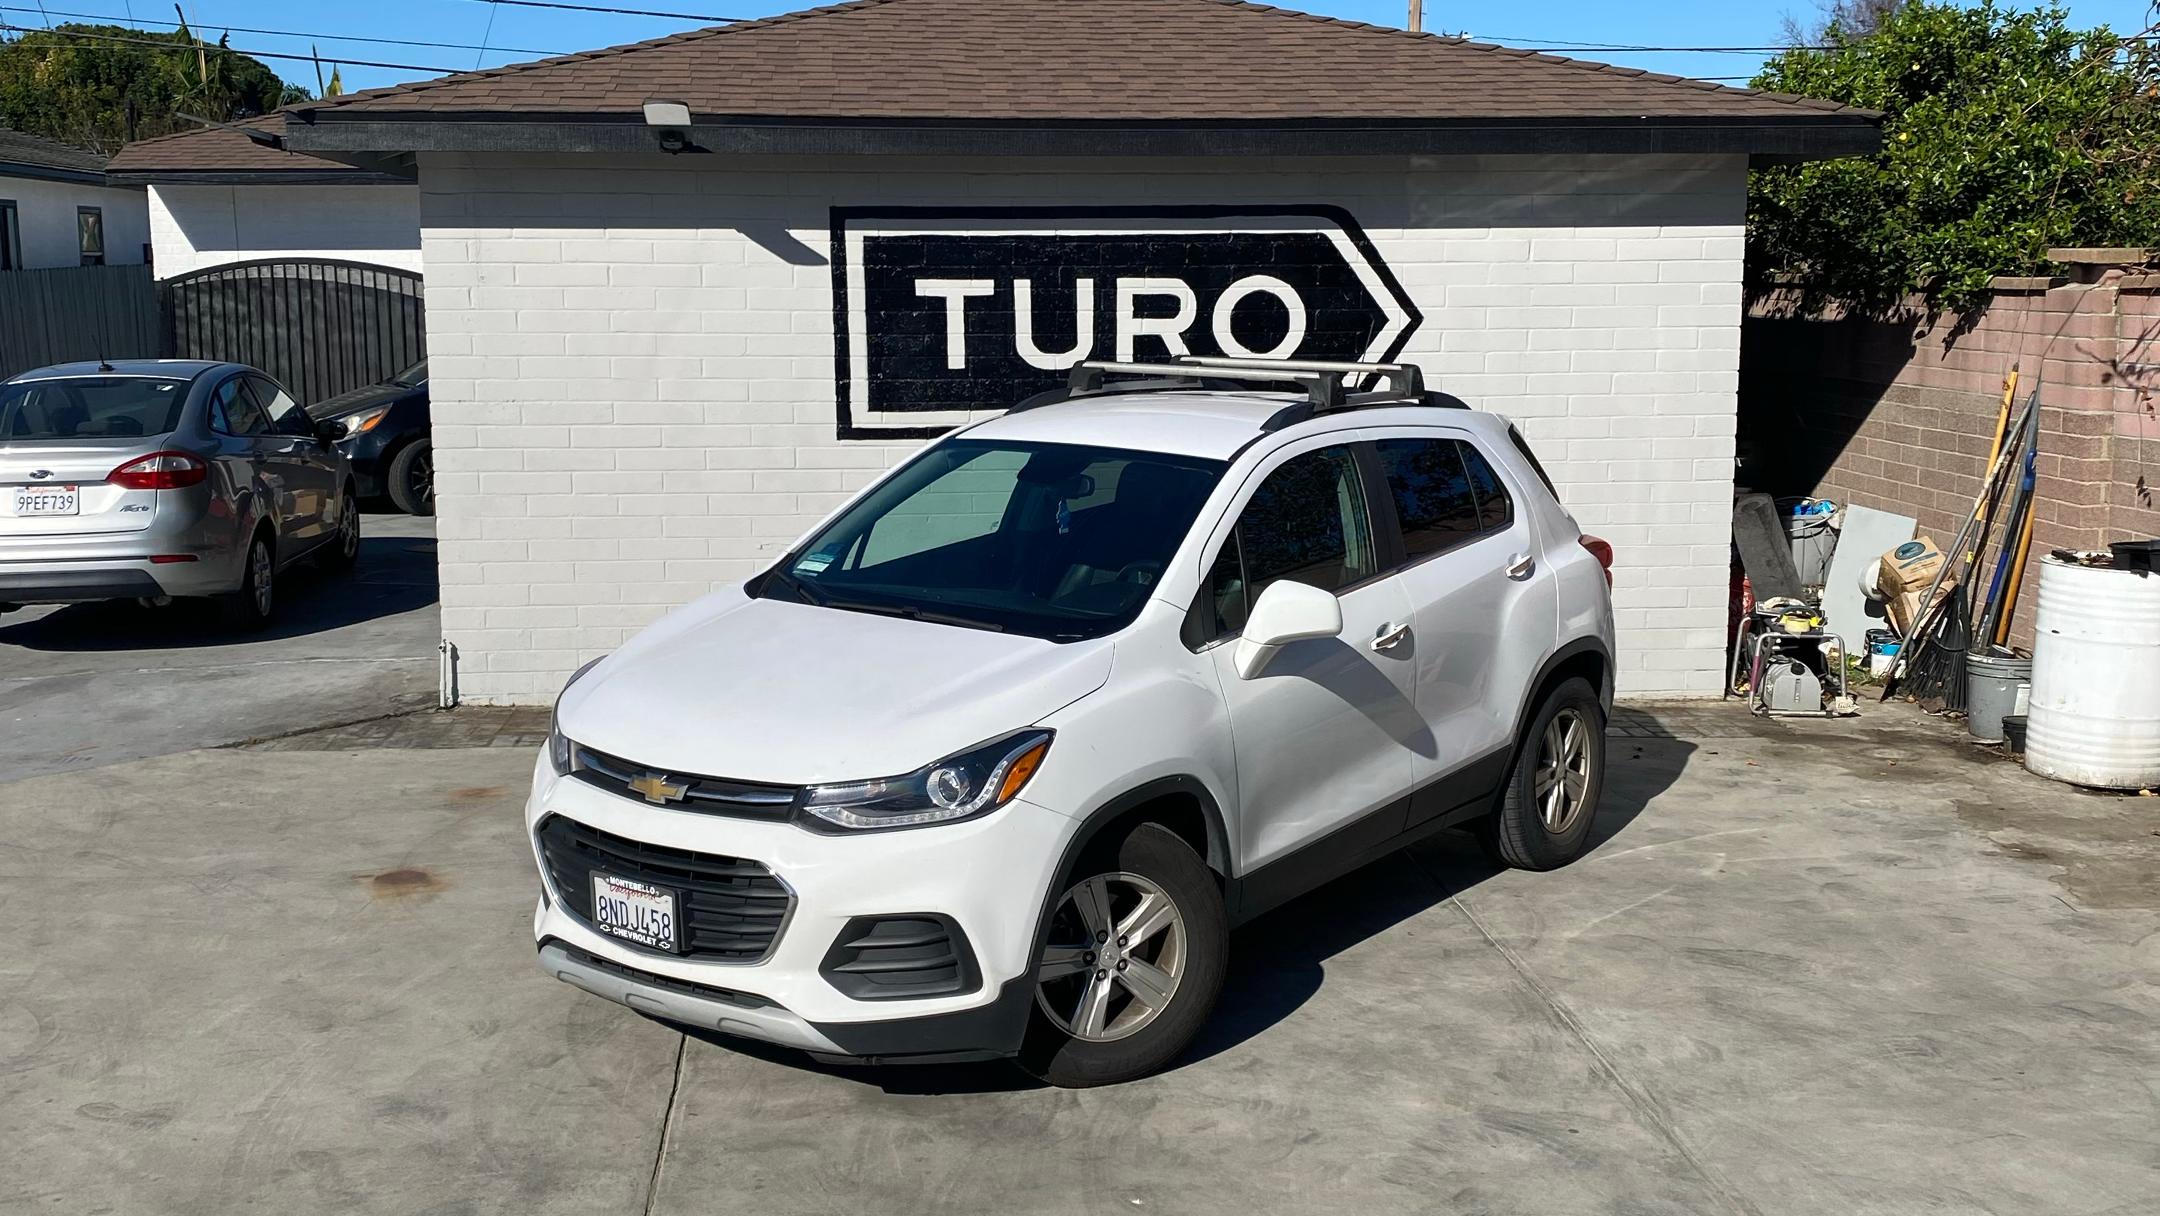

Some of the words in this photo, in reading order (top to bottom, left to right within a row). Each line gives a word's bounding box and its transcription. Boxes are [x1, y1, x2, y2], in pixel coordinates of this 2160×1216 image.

[914, 274, 1307, 370] TURO
[18, 495, 74, 512] 9PEF739
[609, 876, 656, 895] MONTEBELLO
[598, 895, 672, 941] 8NDJ458
[612, 927, 657, 946] CHEVROLET
